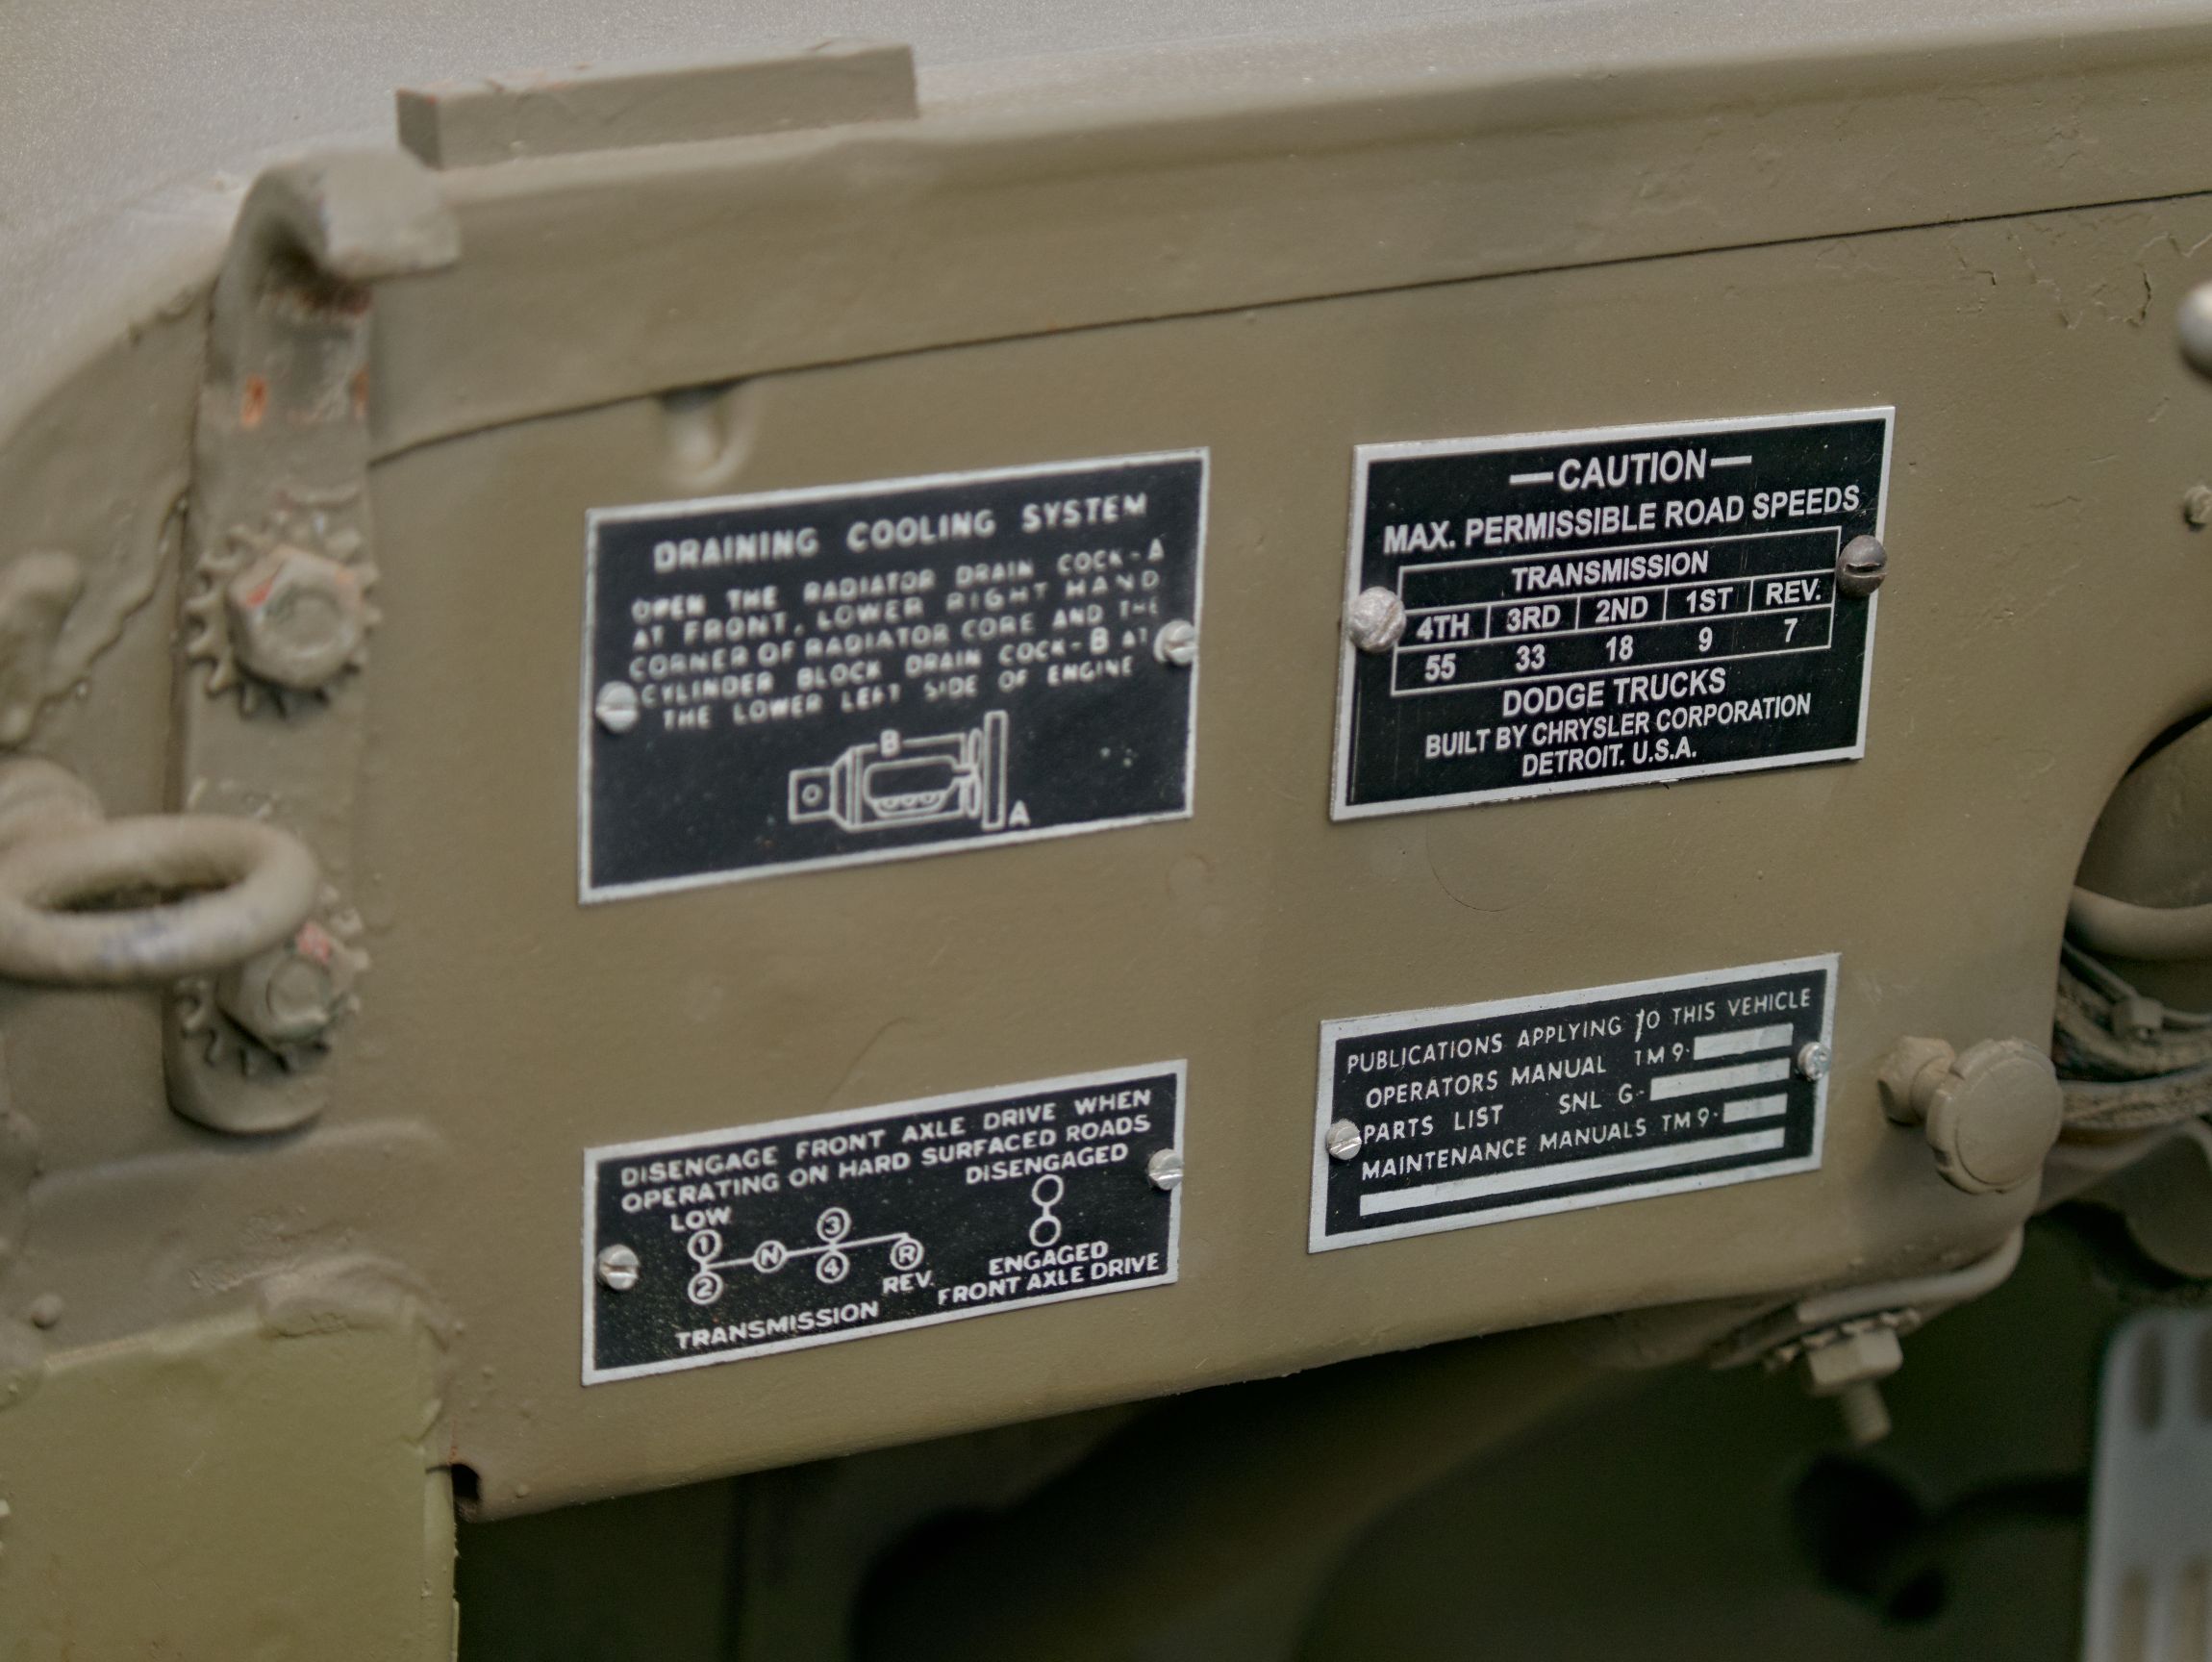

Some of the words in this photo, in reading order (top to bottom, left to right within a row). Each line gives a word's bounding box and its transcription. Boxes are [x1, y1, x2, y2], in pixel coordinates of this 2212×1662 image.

[654, 528, 818, 572] DRAINING
[846, 509, 995, 552] COOLING
[1022, 492, 1146, 532] SYSTEM
[1384, 520, 1455, 554] MAX.
[1465, 503, 1656, 546] PERMISSIBLE
[1665, 495, 1744, 528] ROAD
[1752, 485, 1859, 519] SPEEDS
[726, 586, 776, 611] THE
[803, 568, 935, 603] RADIATOR
[956, 561, 1033, 589] DRAIN
[1512, 550, 1708, 592] TRANSMISSION
[633, 625, 664, 649] AT
[817, 597, 923, 630] LOWER
[946, 582, 1047, 611] RIGHT
[1066, 570, 1159, 597] HAND
[1417, 613, 1470, 641] 4TH
[1507, 605, 1560, 632] 3RD
[1596, 596, 1647, 623] 2ND
[1687, 587, 1733, 613] 1ST
[1766, 578, 1821, 605] REV.
[629, 646, 748, 681] CORNER
[758, 641, 794, 667] OF
[805, 623, 949, 657] RADIATOR
[961, 613, 1033, 641] CORE
[1052, 604, 1103, 629] AND
[1425, 653, 1456, 681] 55
[1516, 644, 1545, 671] 33
[1606, 635, 1633, 662] 18
[1699, 627, 1712, 651] 9
[1784, 618, 1797, 642] 7
[641, 671, 773, 706] CYLINDER
[797, 661, 881, 691] BLOCK
[905, 649, 981, 677] DRAIN
[664, 705, 710, 729] THE
[733, 693, 821, 724] LOWER
[924, 674, 977, 700] SIDE
[998, 668, 1027, 692] OF
[1047, 656, 1132, 686] ENGINE
[1503, 681, 1604, 717] DODGE
[1614, 667, 1725, 704] TRUCKS
[880, 729, 900, 757] B
[1425, 728, 1491, 759] BUILT
[1496, 724, 1527, 750] BY
[1532, 712, 1649, 745] CHRYSLER
[1656, 692, 1811, 732] CORPORATION
[1522, 743, 1624, 777] DETROIT.
[1633, 736, 1697, 764] U.S.A.
[1009, 800, 1030, 826] A
[1347, 1033, 1502, 1073] PUBLICATIONS
[1518, 1016, 1621, 1047] APPLYING
[1672, 1001, 1715, 1024] THIS
[1727, 988, 1810, 1016] VEHICLE
[1366, 1070, 1497, 1108] OPERATORS
[1512, 1056, 1606, 1085] MANUAL
[621, 1146, 776, 1187] DISENGAGE
[796, 1129, 885, 1160] FRONT
[902, 1117, 966, 1143] AXLE
[984, 1103, 1056, 1130] DRIVE
[1074, 1090, 1151, 1116] WHEN
[1365, 1116, 1433, 1144] PARTS
[1454, 1104, 1503, 1130] LIST
[1559, 1091, 1601, 1115] SNL
[621, 1172, 779, 1213] OPERATING
[788, 1165, 828, 1187] ON
[839, 1152, 911, 1178] HARD
[921, 1129, 1056, 1166] SURFACED
[1067, 1115, 1150, 1142] ROADS
[967, 1143, 1128, 1184] DISENGAGED
[1363, 1137, 1526, 1180] MAINTENANCE
[1540, 1118, 1646, 1151] MANUALS
[671, 1206, 730, 1232] LOW
[939, 1276, 1020, 1304] FRONT
[1026, 1267, 1084, 1291] AXLE
[1091, 1252, 1159, 1279] DRIVE
[990, 1241, 1108, 1275] ENGAGED
[675, 1301, 878, 1349] TRANSMISSION
